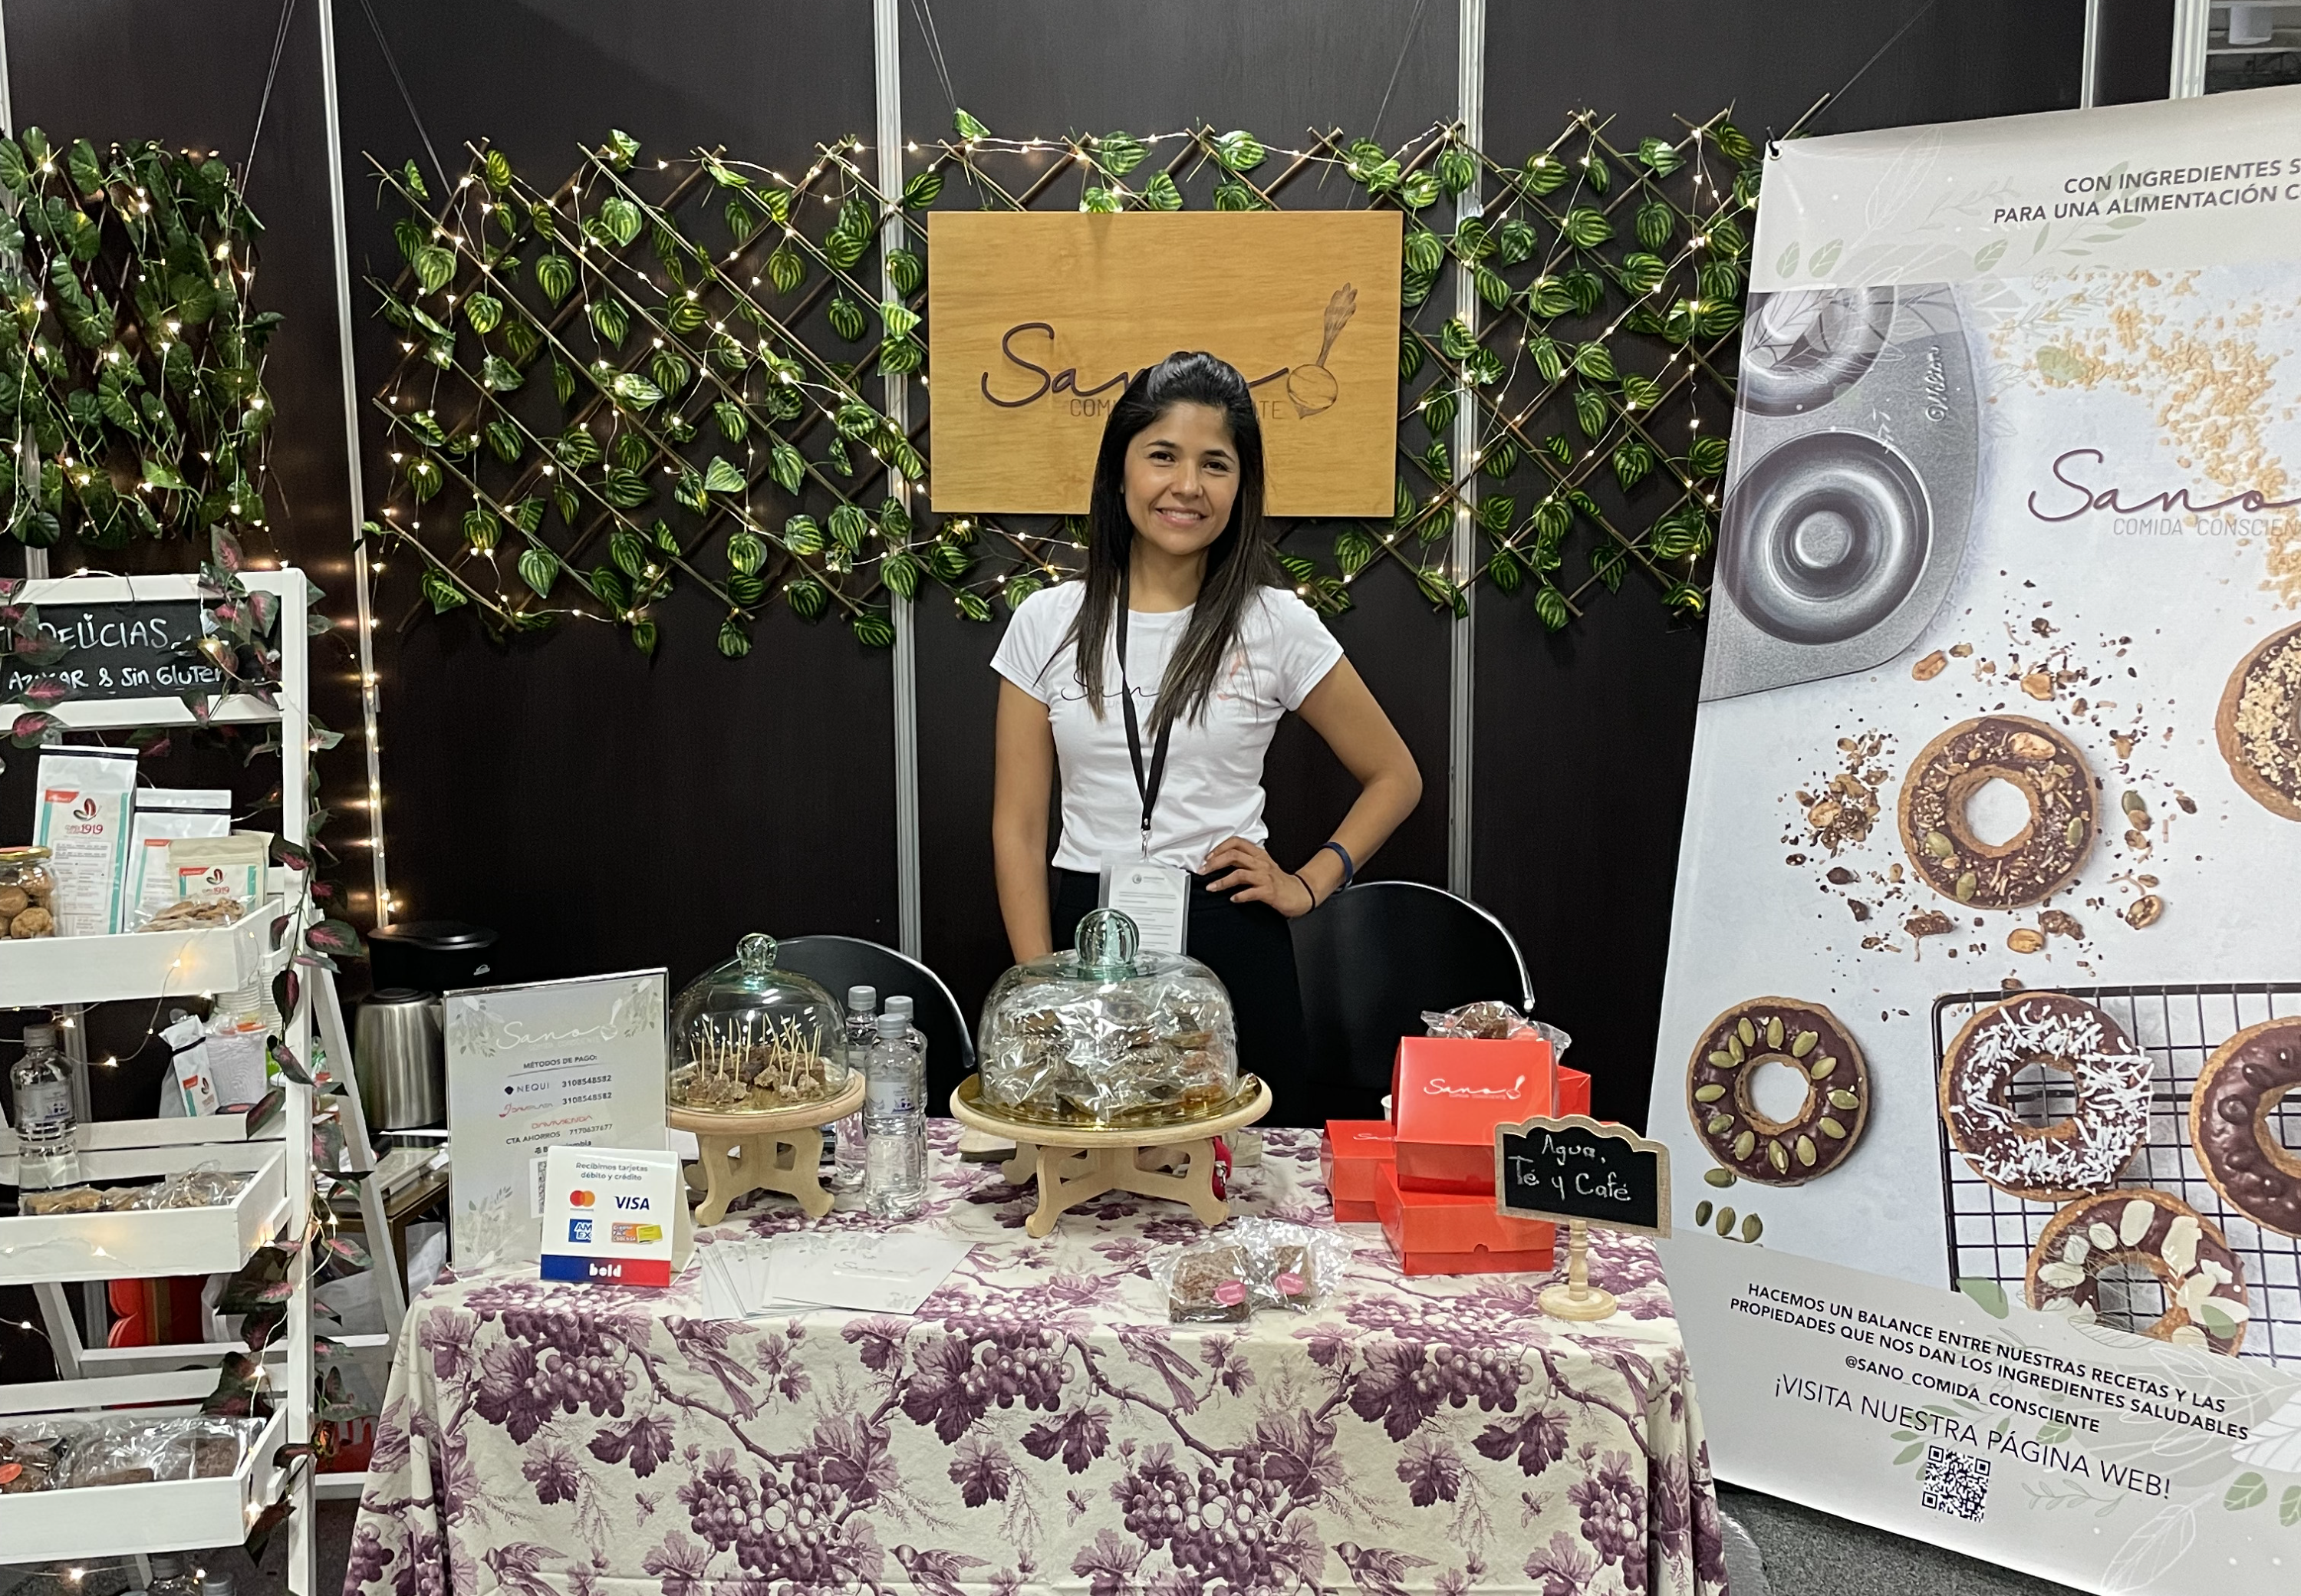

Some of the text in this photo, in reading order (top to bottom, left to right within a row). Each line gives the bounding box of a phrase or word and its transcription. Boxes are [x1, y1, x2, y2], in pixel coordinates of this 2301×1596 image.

[2064, 176, 2112, 194] CON
[2118, 159, 2281, 190] INGREDIENTES
[1993, 206, 2046, 224] PARA
[2054, 201, 2100, 219] UNA
[2106, 183, 2278, 216] ALIMENTACIÓN
[2028, 449, 2301, 522] Sano
[2113, 518, 2184, 536] COMIDA
[495, 1021, 601, 1050] Sano
[523, 1058, 561, 1069] MÉTODOS
[574, 1055, 597, 1063] PAGO:
[516, 1082, 549, 1093] NEQUI
[522, 1131, 561, 1142] AHORROS
[576, 1162, 648, 1173] Recibimos tarjetas
[614, 1173, 642, 1181] crédito
[1551, 1176, 1565, 1201] y
[1575, 1171, 1631, 1201] Café
[614, 1196, 650, 1210] VISA
[574, 1222, 592, 1232] AM
[589, 1262, 622, 1278] bold
[1748, 1283, 2226, 1413] HACEMOS UN BALANCE ENTRE NUESTRAS RECETAS Y LAS
[1730, 1298, 2249, 1440] PROPIEDADES QUE NOS DAN LOS INGREDIENTES SALUDABLES
[1845, 1355, 2100, 1433] @SANO_COMIDA_CONSCIENTE
[1775, 1373, 2171, 1499] ¡VISITA NUESTRA PÁGINA WEB!
